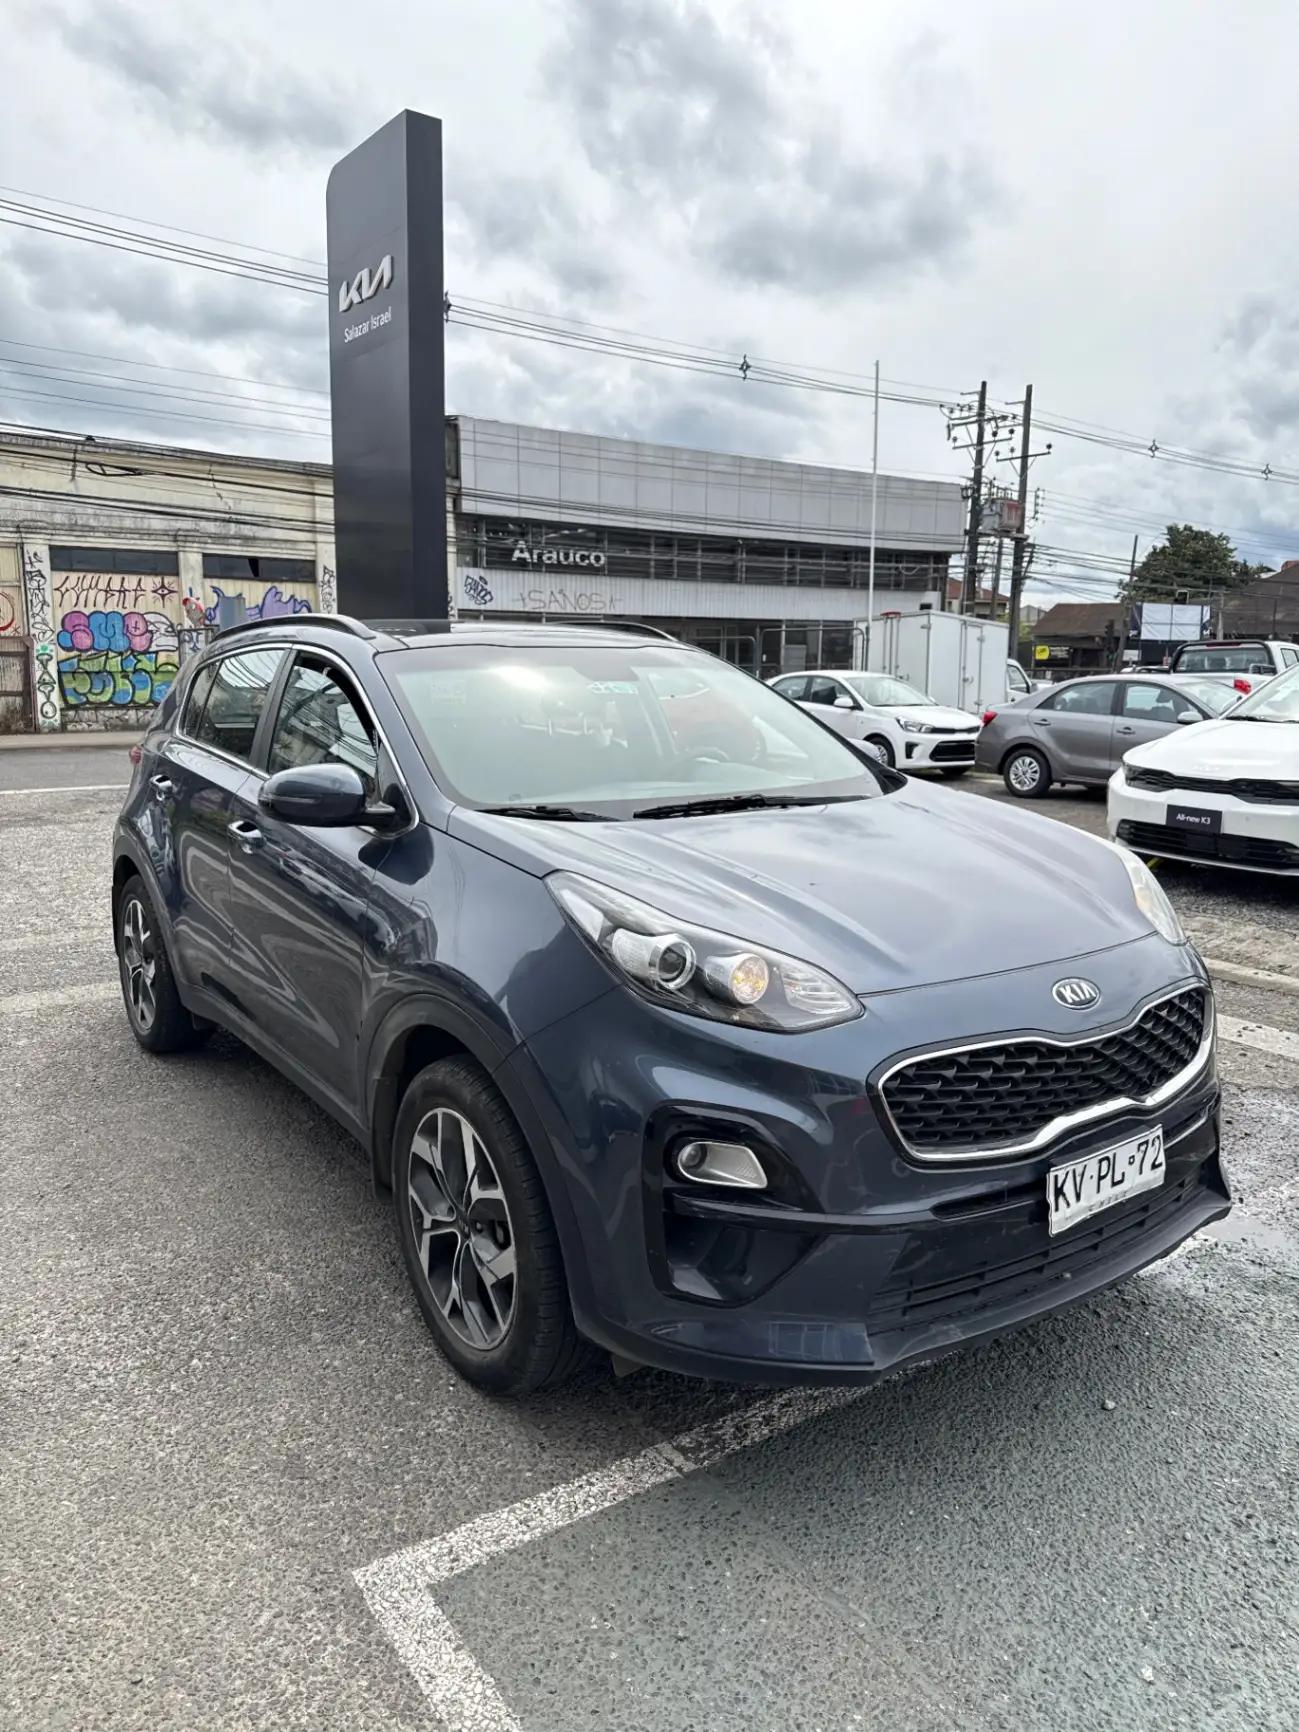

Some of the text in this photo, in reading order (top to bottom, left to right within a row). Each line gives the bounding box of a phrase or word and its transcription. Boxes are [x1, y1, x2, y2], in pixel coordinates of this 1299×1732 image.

[344, 306, 392, 343] Salazar Israel
[511, 540, 605, 567] Arauco
[1176, 812, 1200, 824] All-new
[1059, 982, 1097, 1003] KIA
